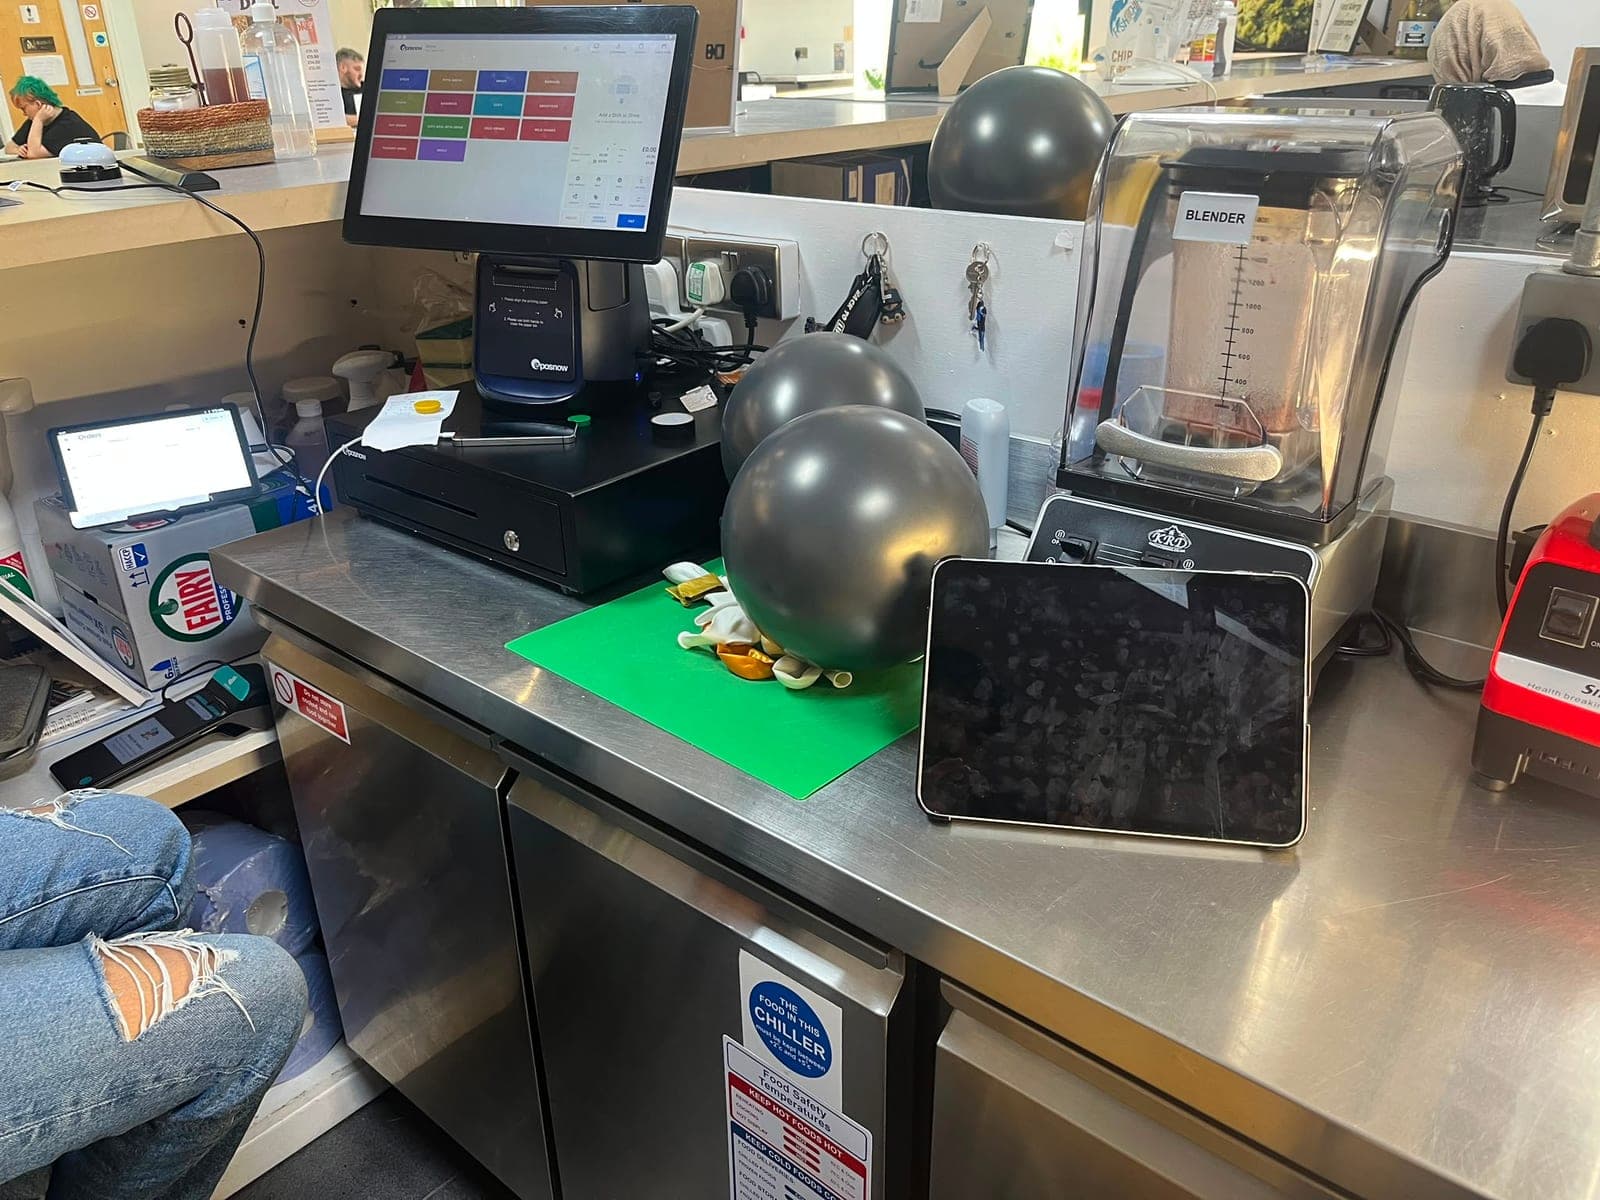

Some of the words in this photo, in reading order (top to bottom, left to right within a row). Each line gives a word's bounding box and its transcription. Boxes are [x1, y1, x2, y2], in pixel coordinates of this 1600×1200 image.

[1111, 49, 1133, 62] CHIP
[1185, 209, 1246, 224] BLENDER
[846, 289, 861, 311] BACK
[841, 310, 850, 321] TO
[1238, 353, 1251, 361] 600
[1234, 378, 1247, 386] 400
[78, 433, 102, 441] Orders
[121, 548, 134, 569] HACCP
[174, 567, 222, 631] FAIRY
[1527, 682, 1561, 697] Health
[779, 996, 798, 1014] THE
[759, 994, 785, 1016] FOOD
[787, 1011, 797, 1023] IN
[798, 1018, 820, 1038] THIS
[754, 1006, 826, 1061] CHILLER
[756, 1024, 772, 1038] must
[773, 1032, 781, 1043] be
[782, 1040, 797, 1053] kept
[797, 1049, 826, 1073] between
[784, 1049, 797, 1060] and
[762, 1069, 790, 1092] Food
[792, 1088, 827, 1120] Safety
[758, 1075, 831, 1133] Temperatures
[748, 1087, 772, 1107] KEEP
[772, 1104, 791, 1121] HOT
[792, 1117, 822, 1145] FOODS
[823, 1139, 845, 1159] HOT
[737, 1139, 755, 1155] FOOD
[745, 1132, 767, 1150] KEEP
[768, 1150, 791, 1170] COLD
[792, 1166, 822, 1193] FOODS
[739, 1171, 757, 1186] FOOD
